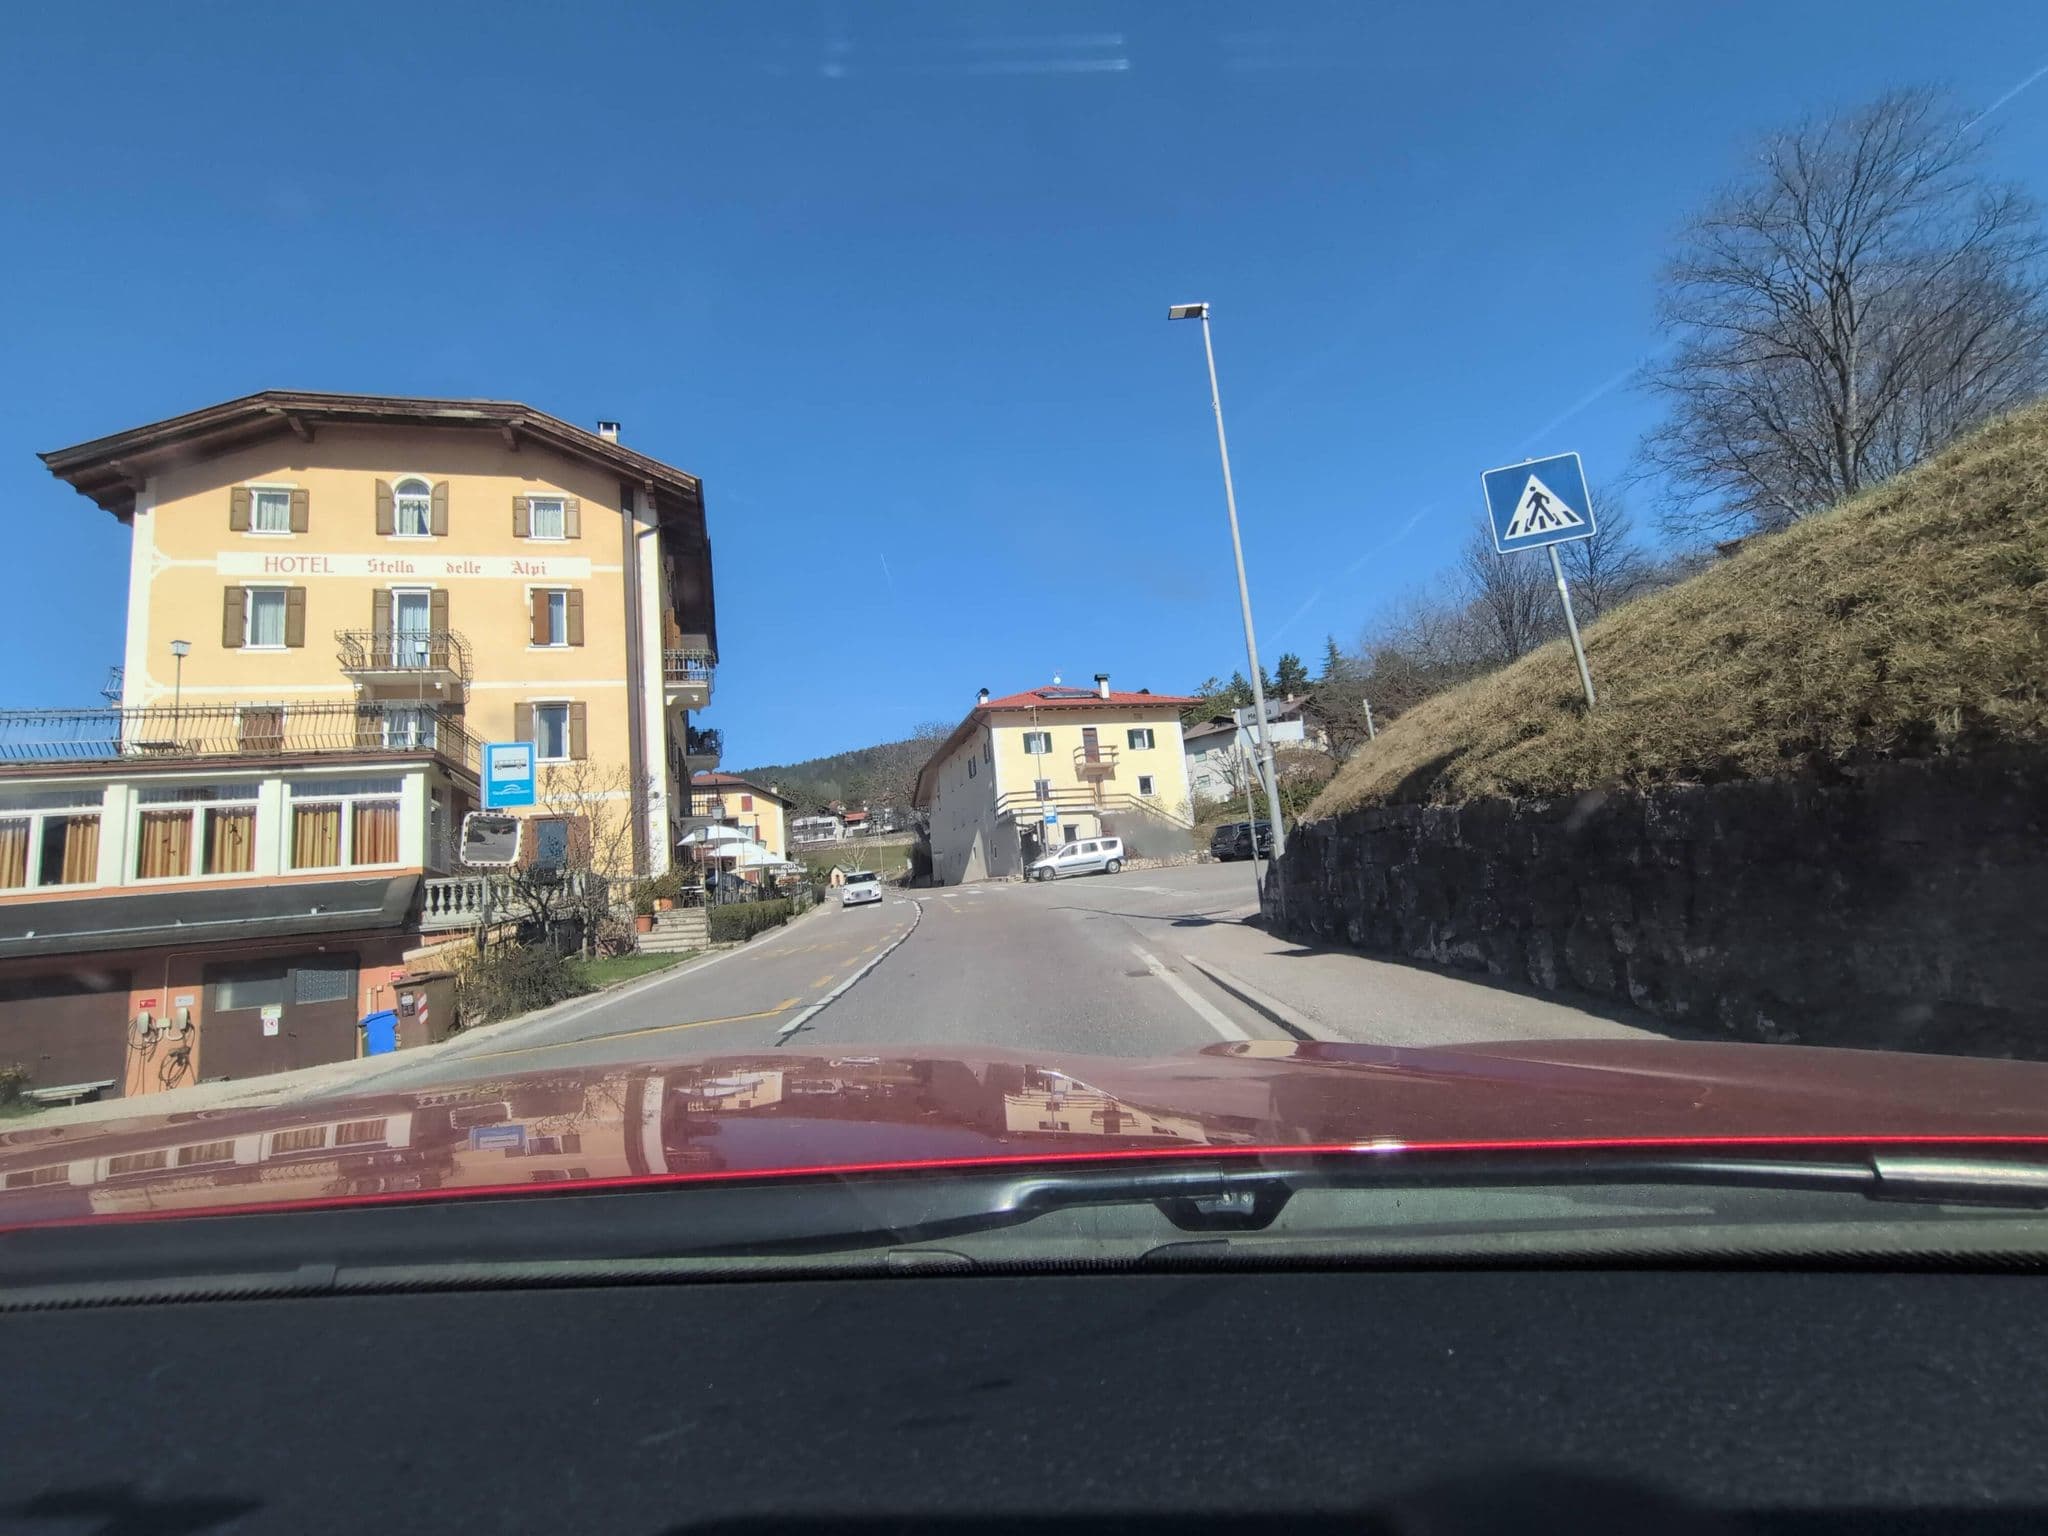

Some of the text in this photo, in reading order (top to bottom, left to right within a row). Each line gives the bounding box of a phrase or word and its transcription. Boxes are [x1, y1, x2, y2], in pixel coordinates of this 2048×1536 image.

[264, 556, 547, 577] HOTEL Stella delle Alpi
